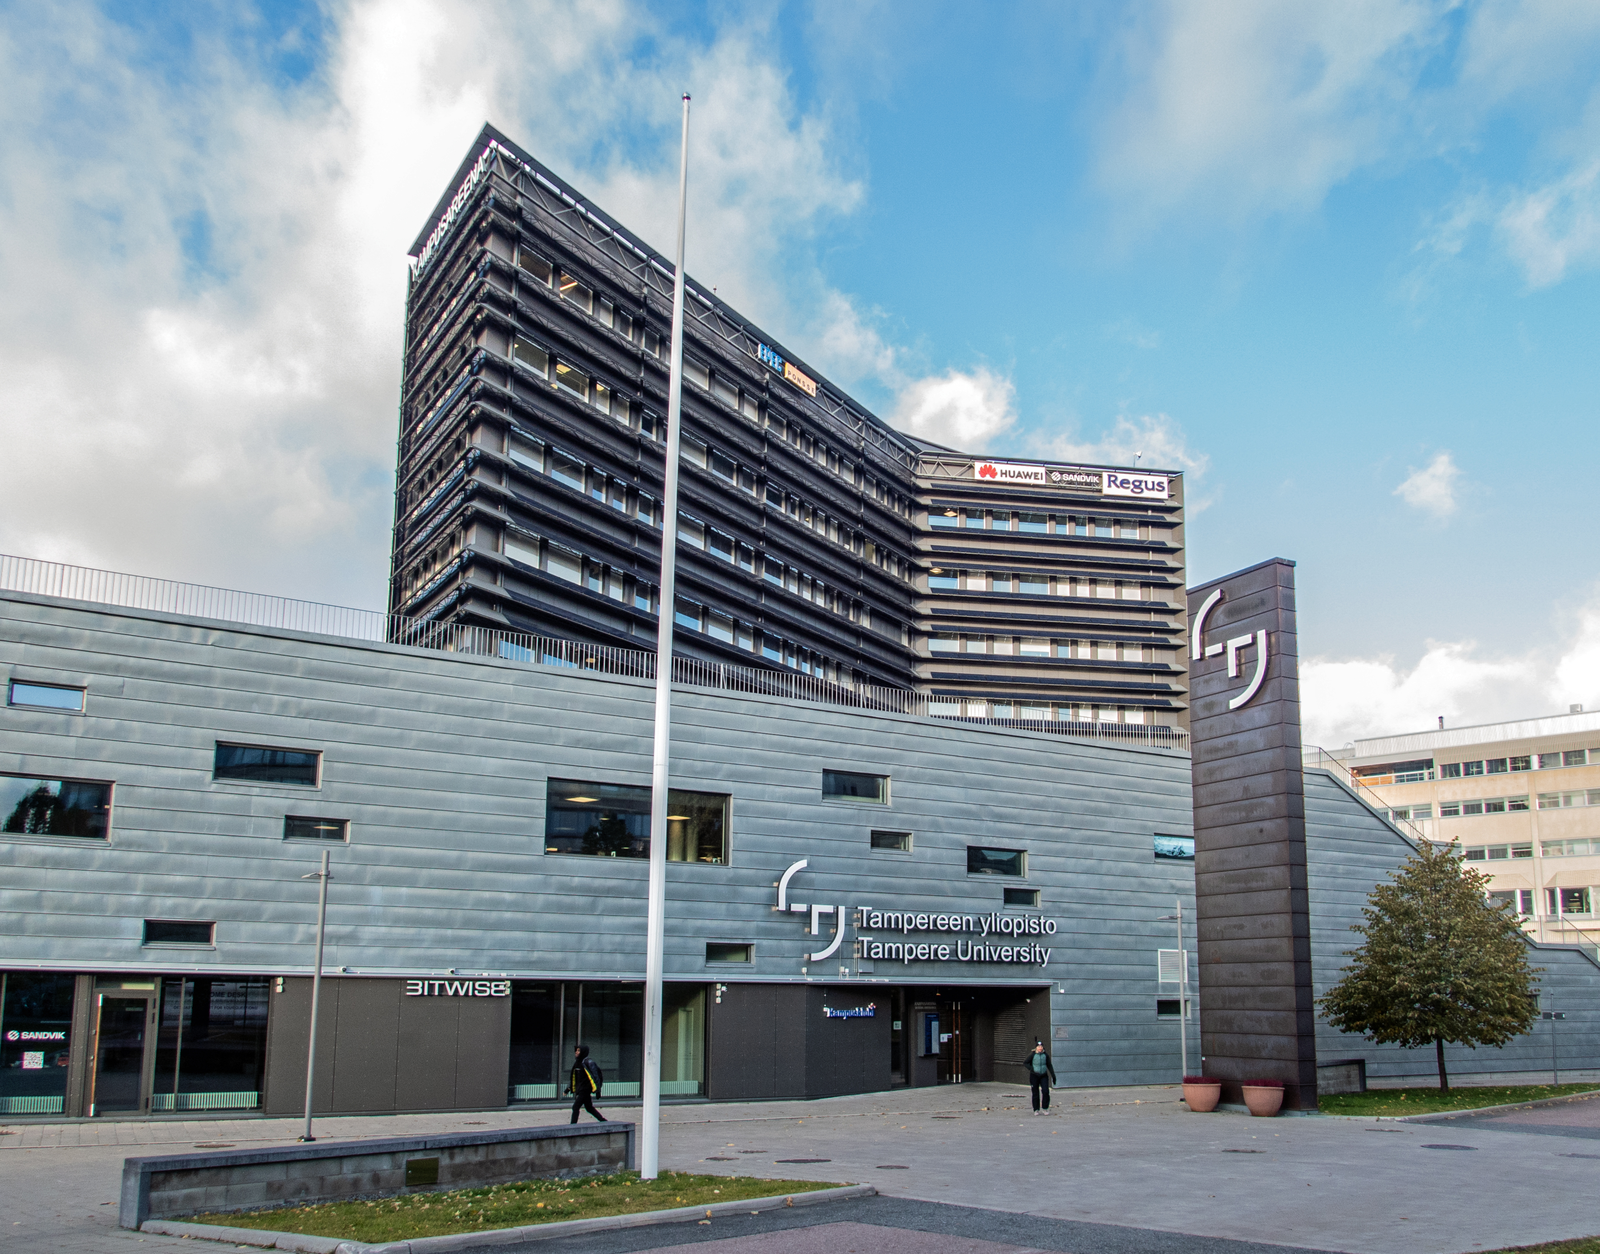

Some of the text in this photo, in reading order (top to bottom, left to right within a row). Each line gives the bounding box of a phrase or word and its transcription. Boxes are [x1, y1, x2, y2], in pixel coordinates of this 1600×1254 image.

[408, 155, 486, 281] KAMPUSAREENA
[787, 370, 815, 394] PONSSE
[1000, 469, 1043, 480] HUAWEI
[1062, 473, 1099, 483] SANDVIK
[1107, 474, 1165, 494] Regus
[857, 906, 1057, 937] Tampereen yliopisto
[857, 937, 1051, 967] Tampere University
[21, 1031, 66, 1040] SANDVIK
